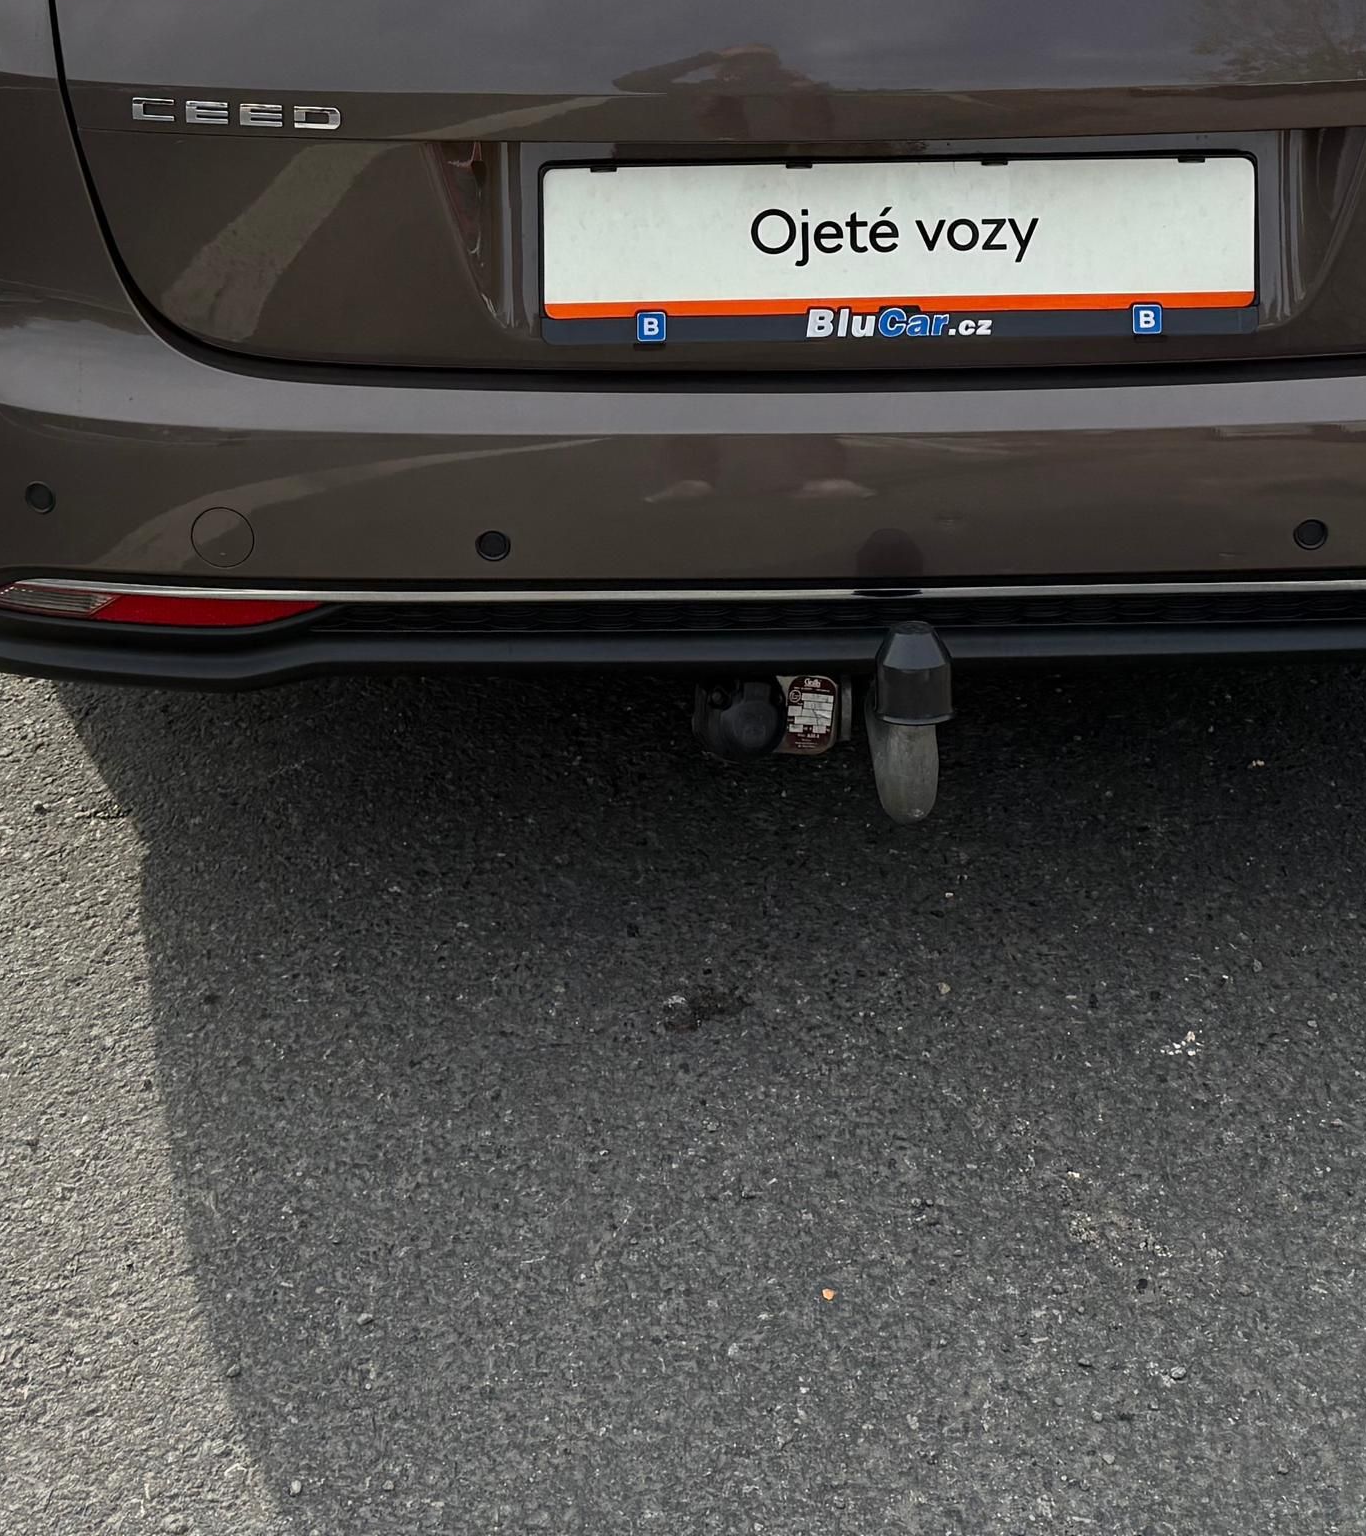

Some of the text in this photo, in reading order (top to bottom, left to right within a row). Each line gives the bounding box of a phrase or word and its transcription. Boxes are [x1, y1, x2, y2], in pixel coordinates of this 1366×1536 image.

[132, 97, 341, 130] CEED
[750, 206, 1039, 267] Ojeté vozy
[643, 317, 660, 335] B
[806, 307, 993, 338] BluCar.cz
[1139, 310, 1156, 328] B
